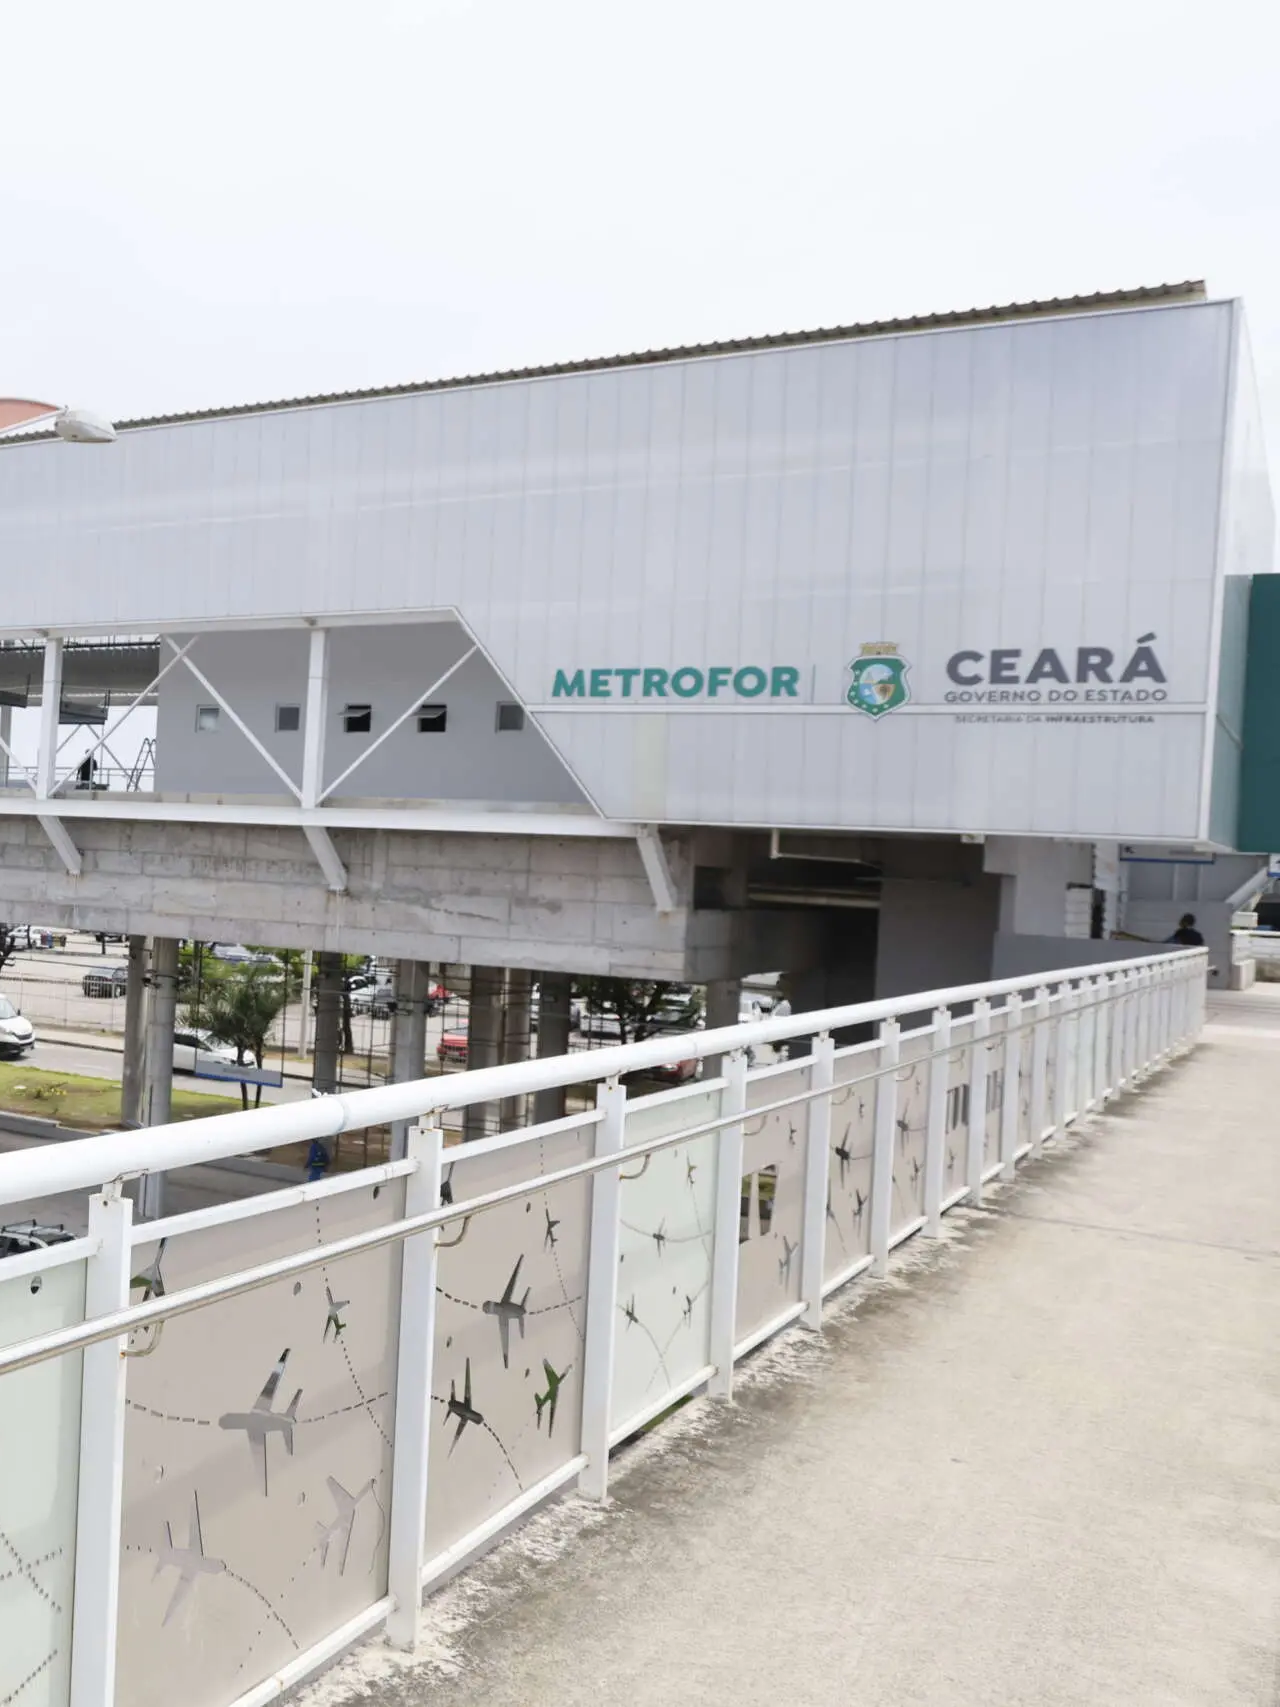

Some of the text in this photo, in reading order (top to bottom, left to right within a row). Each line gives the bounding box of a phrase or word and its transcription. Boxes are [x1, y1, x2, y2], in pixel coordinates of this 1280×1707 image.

[946, 631, 1167, 686] CEARÁ
[552, 666, 800, 698] METROFOR
[944, 688, 1168, 703] GOVERNO DO ESTADO
